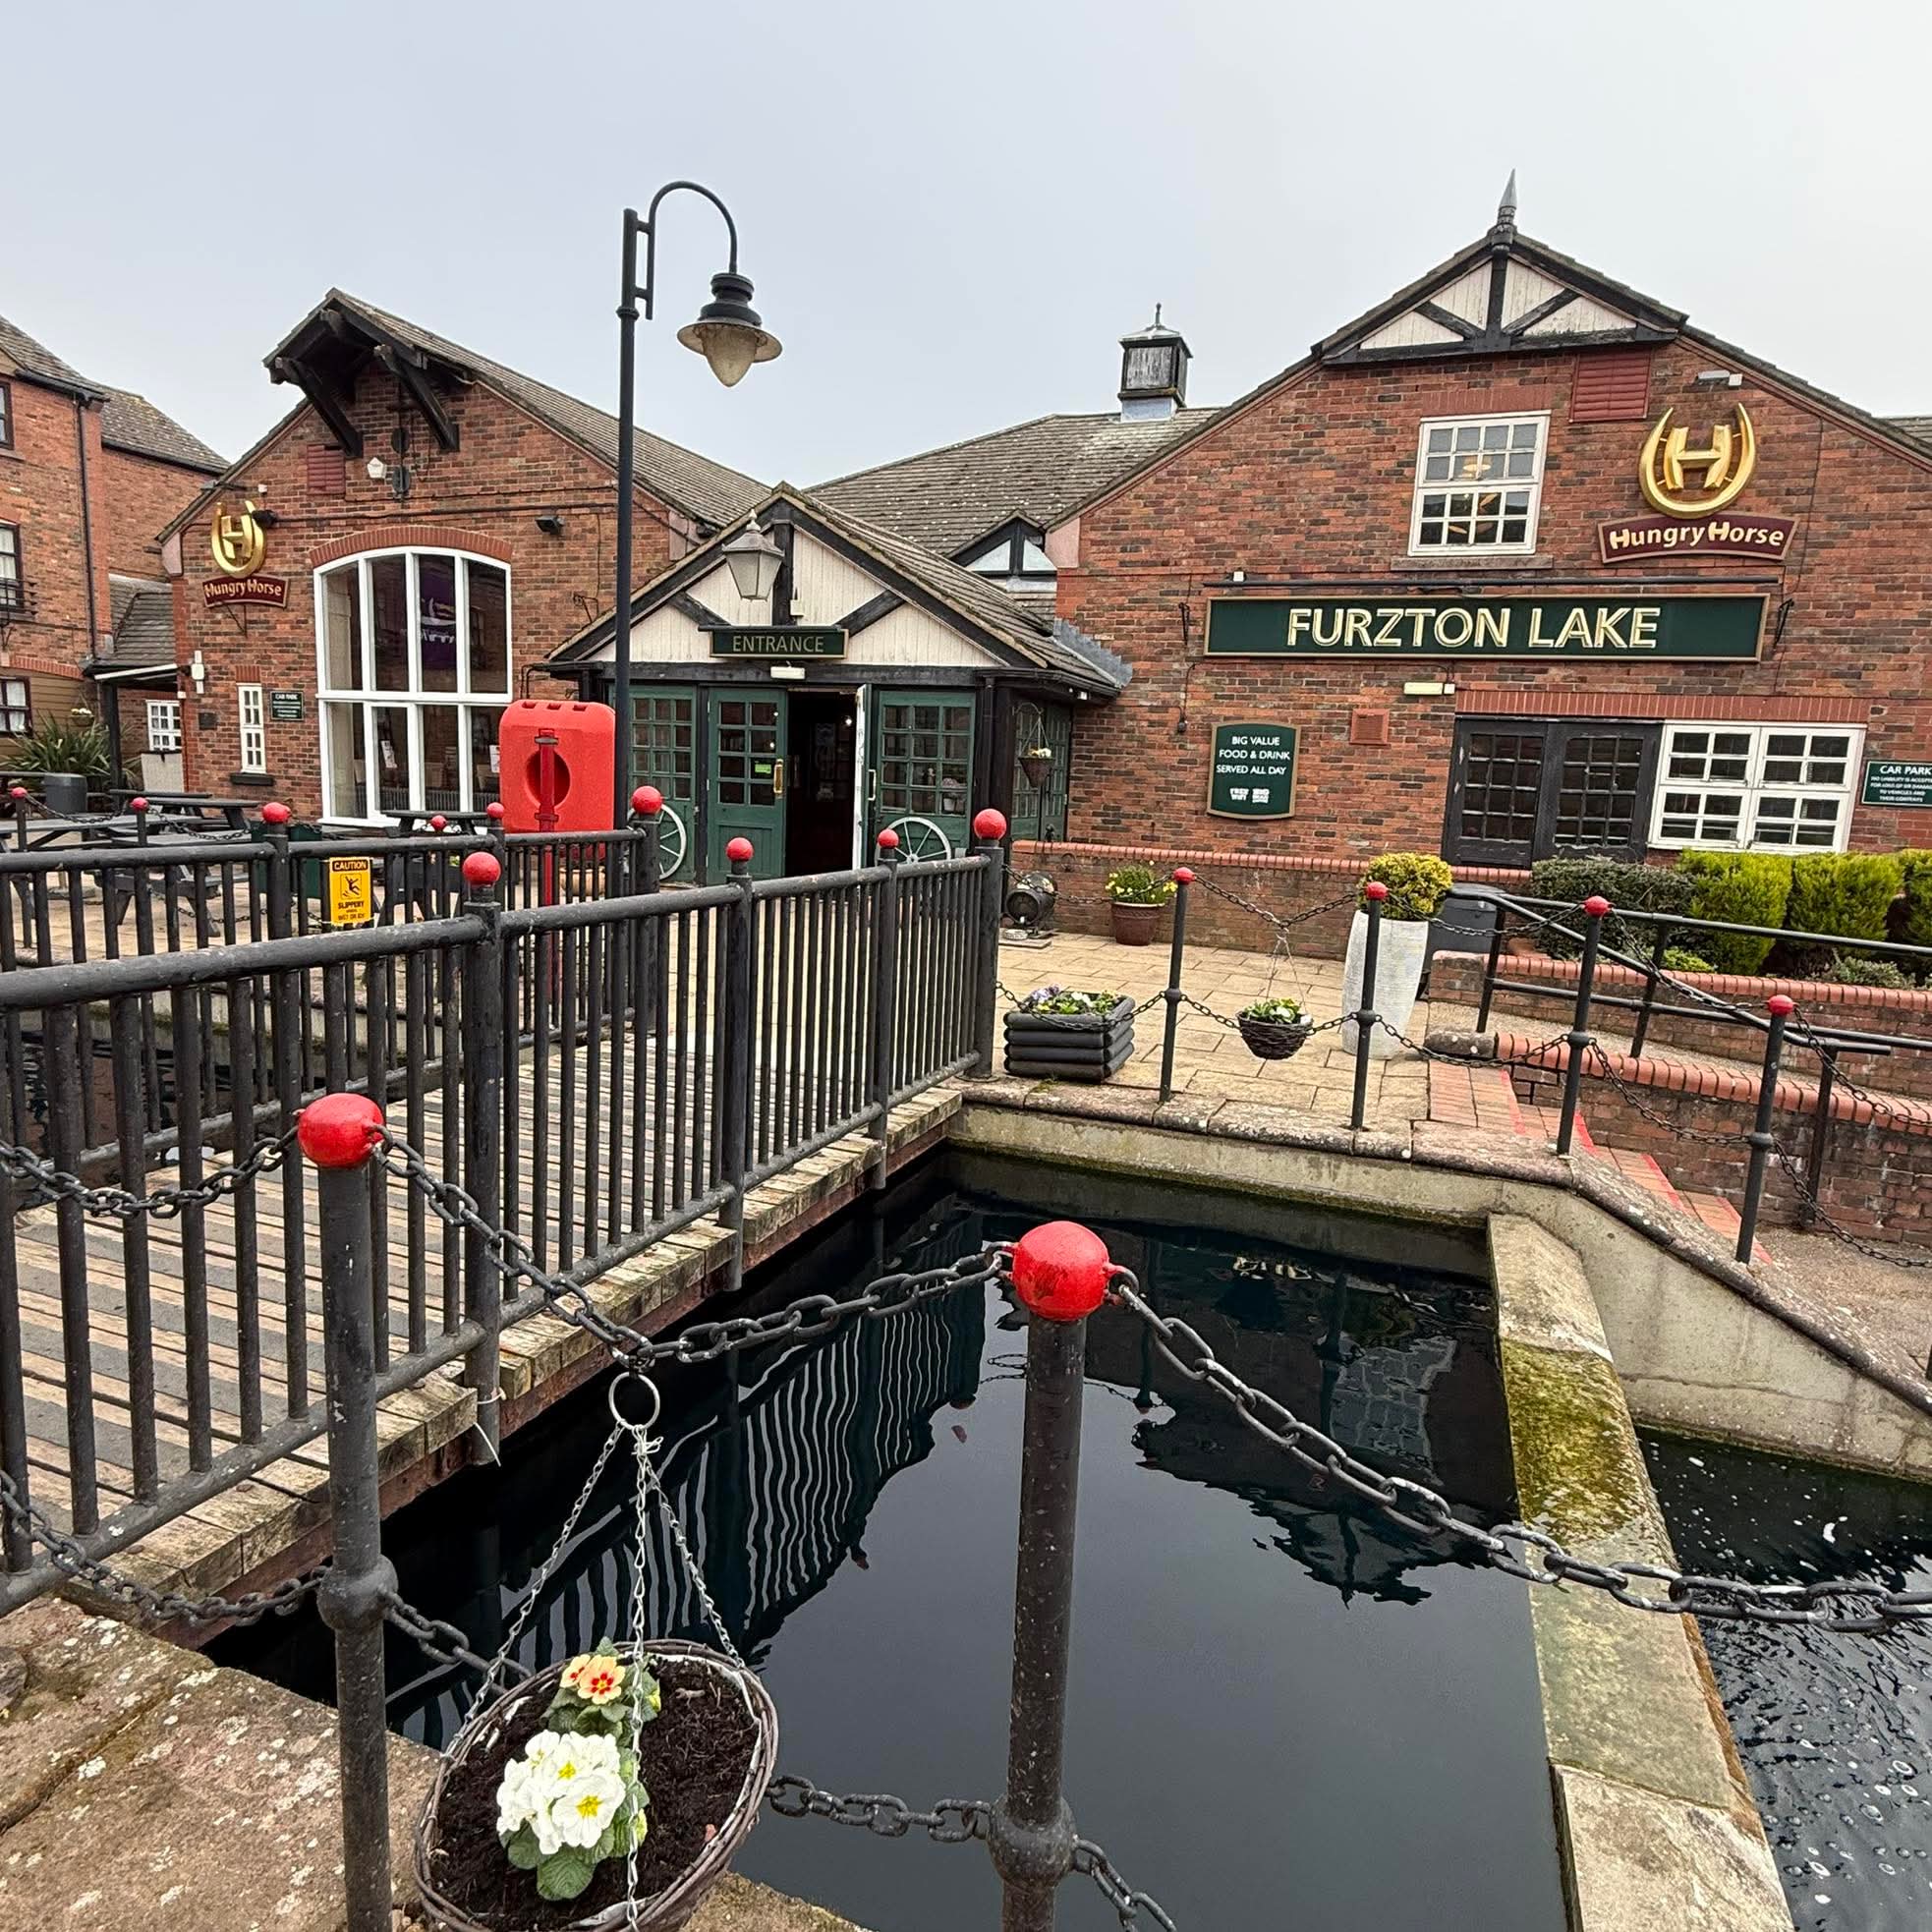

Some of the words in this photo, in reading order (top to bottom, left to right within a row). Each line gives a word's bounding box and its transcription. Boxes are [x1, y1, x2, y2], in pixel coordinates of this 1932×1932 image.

[1609, 526, 1706, 550] Hungry
[1707, 521, 1785, 547] Horse
[203, 581, 246, 598] Hungry
[247, 579, 282, 597] Horse
[1287, 607, 1510, 648] FURZTON
[1528, 607, 1661, 648] LAKE
[732, 635, 824, 653] ENTRANCE
[1231, 735, 1248, 745] BIG
[1250, 736, 1280, 746] VALUE
[1219, 749, 1248, 759] FOOD
[1249, 750, 1257, 760] &
[1259, 750, 1291, 761] DRINK
[1216, 765, 1248, 774] SERVED
[1249, 766, 1267, 775] ALL
[1268, 766, 1287, 775] DAY
[1880, 765, 1903, 774] CAR
[1904, 766, 1932, 775] PARK
[334, 861, 367, 871] CAUTION
